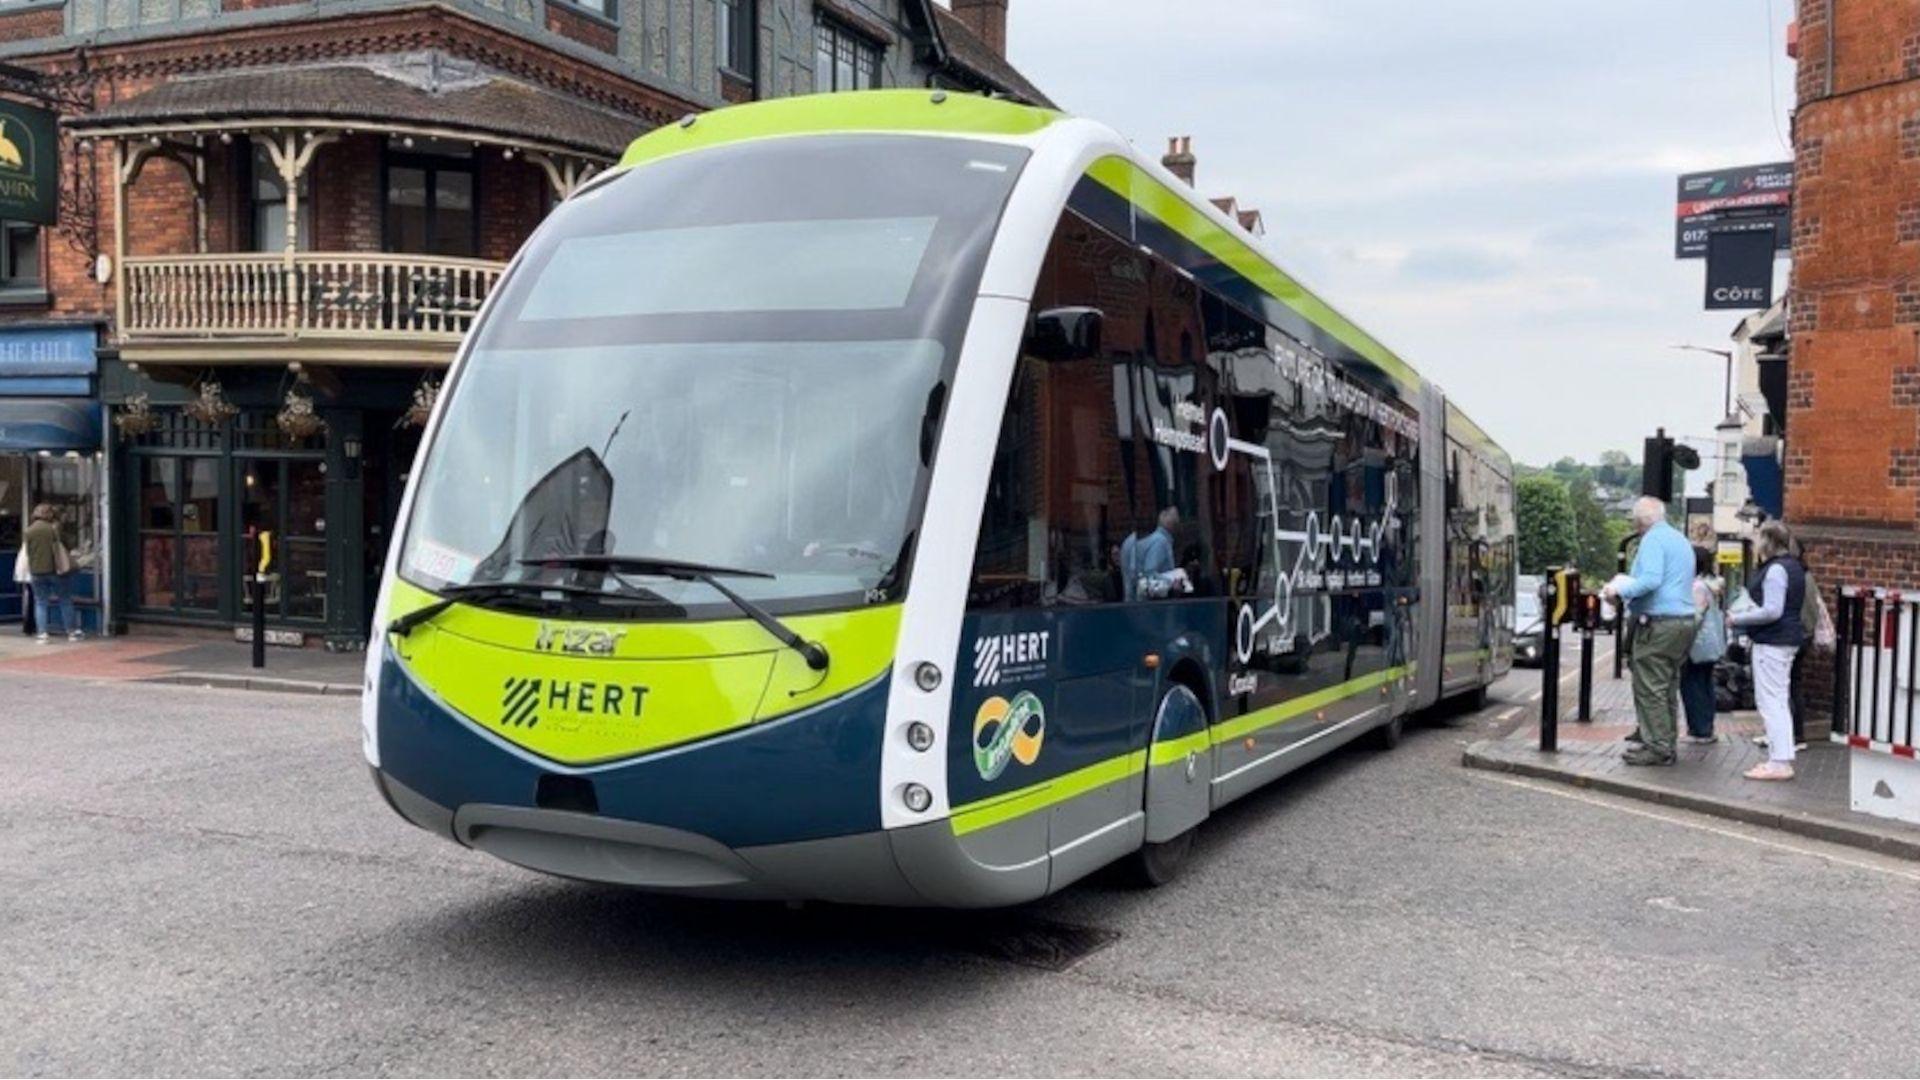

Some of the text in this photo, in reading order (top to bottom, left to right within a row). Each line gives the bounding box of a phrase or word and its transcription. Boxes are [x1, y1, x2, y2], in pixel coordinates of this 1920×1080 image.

[1713, 285, 1763, 302] CÔTE
[31, 341, 80, 362] HILL
[1002, 631, 1049, 664] HERT
[549, 679, 649, 716] HERT
